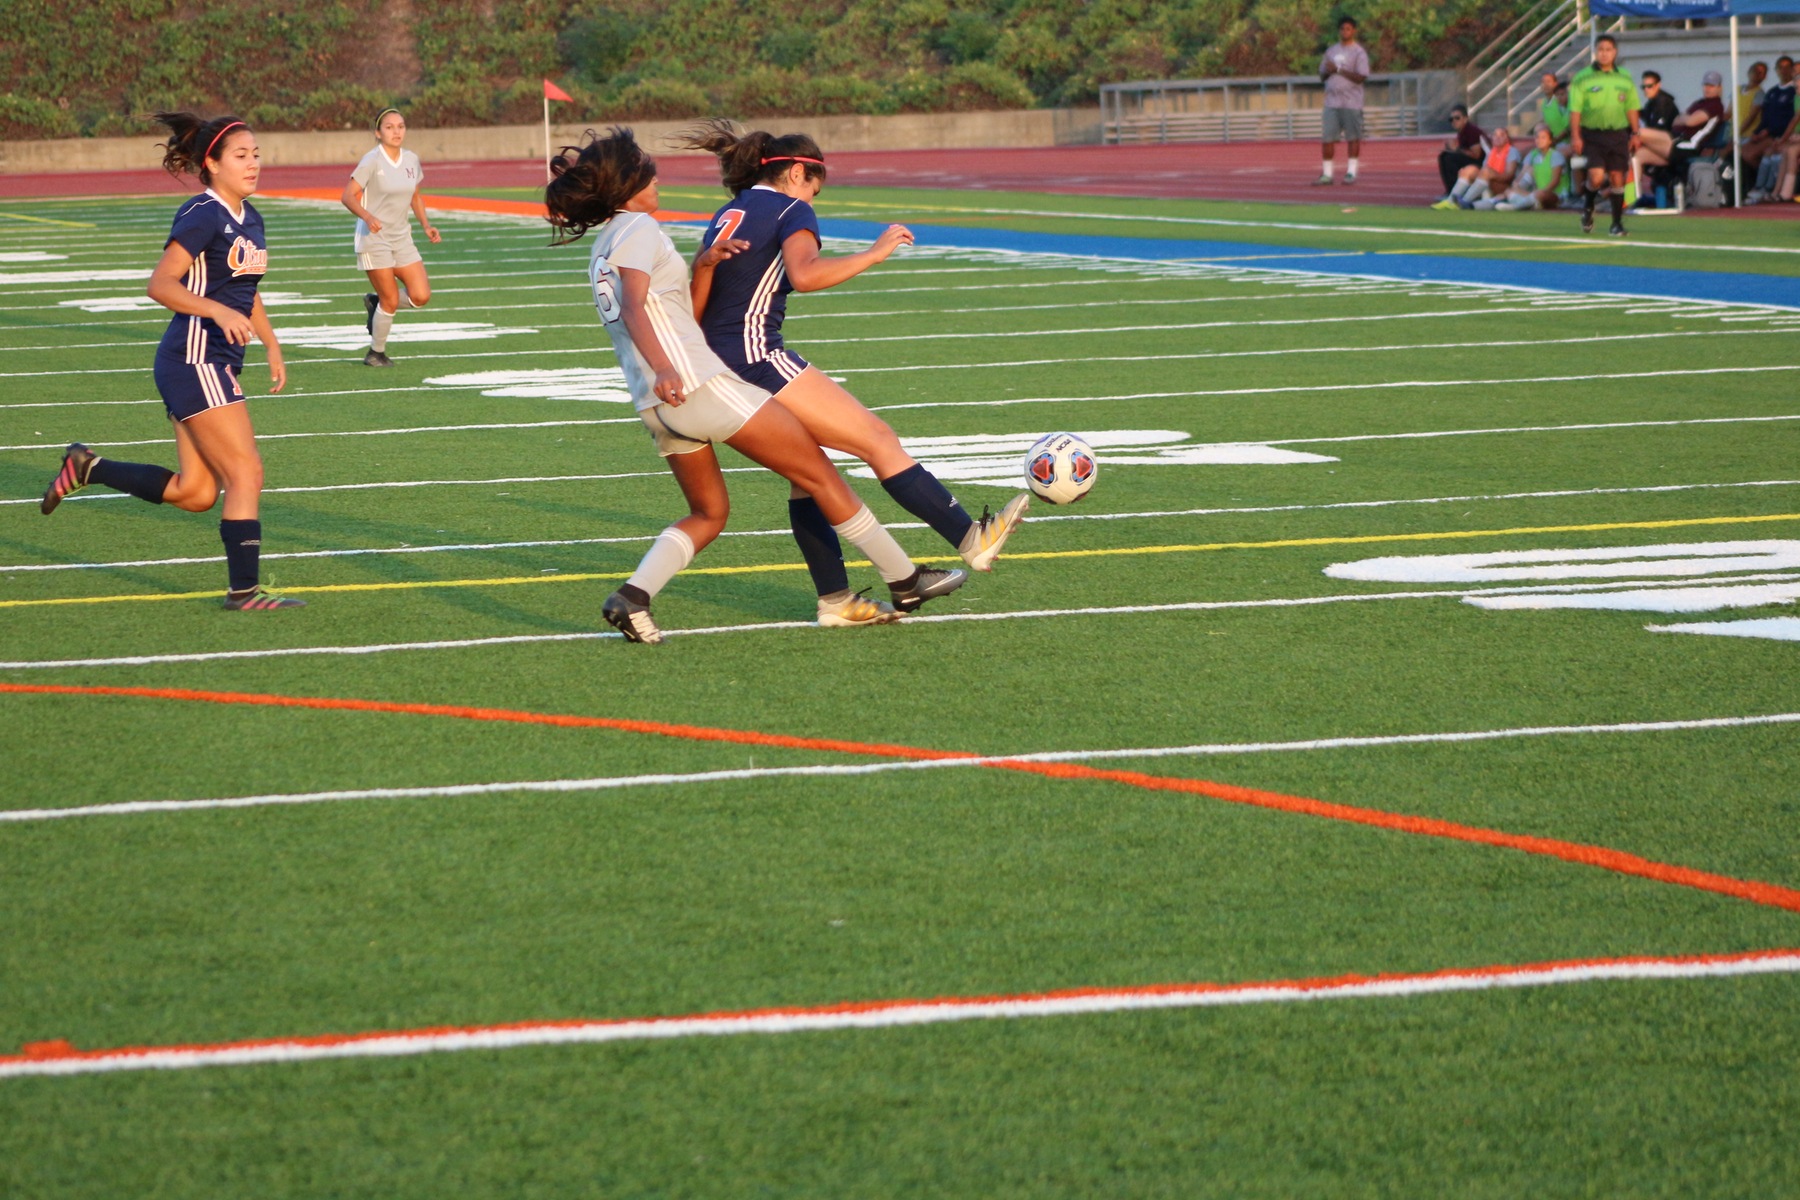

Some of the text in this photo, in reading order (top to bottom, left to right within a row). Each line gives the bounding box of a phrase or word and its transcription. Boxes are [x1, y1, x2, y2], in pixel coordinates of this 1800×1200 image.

[405, 167, 415, 179] M
[712, 208, 746, 247] 7
[1056, 438, 1072, 453] NCAA
